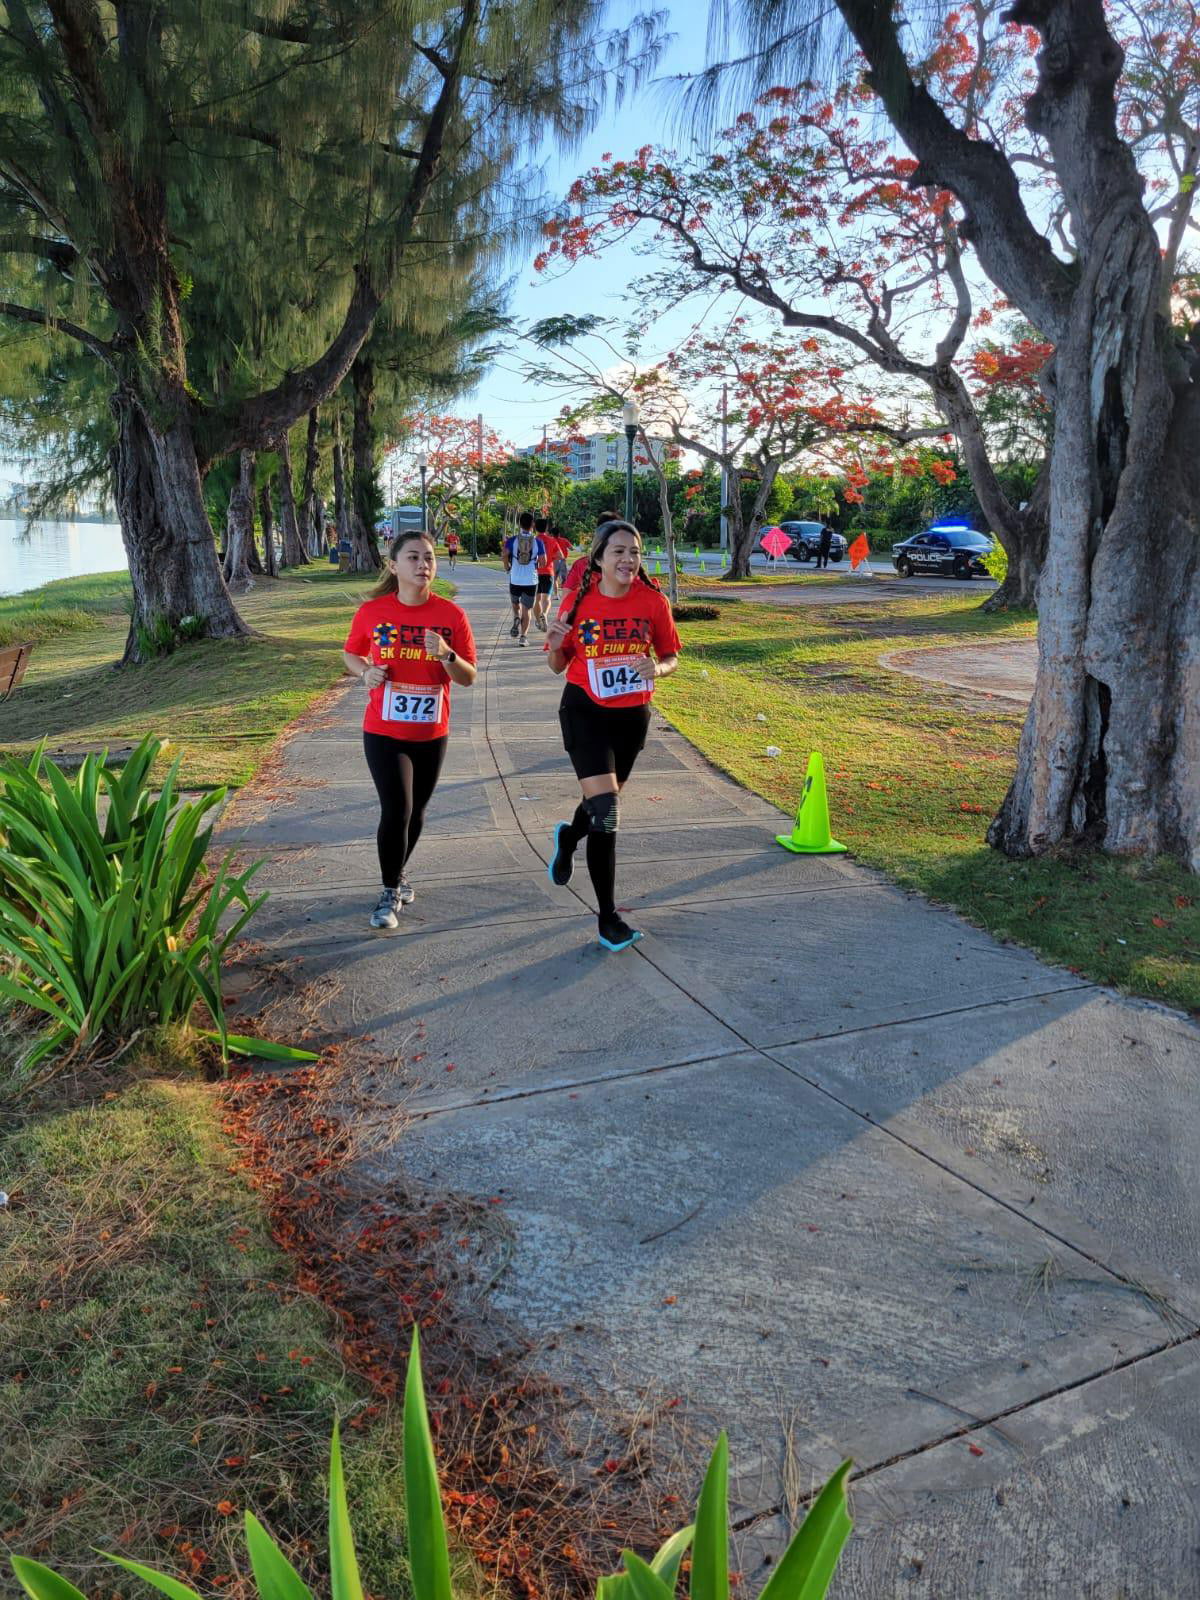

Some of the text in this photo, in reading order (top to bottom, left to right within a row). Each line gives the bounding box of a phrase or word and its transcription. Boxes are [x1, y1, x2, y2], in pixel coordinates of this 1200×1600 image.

[911, 553, 942, 562] POLICE
[603, 618, 627, 627] FIT
[401, 625, 452, 637] FIT TO
[603, 628, 643, 640] LEA
[380, 647, 395, 659] 5K
[400, 648, 423, 660] FUN
[585, 645, 599, 657] 5K
[603, 643, 625, 655] FUN
[602, 667, 642, 688] 042
[395, 695, 435, 714] 372
